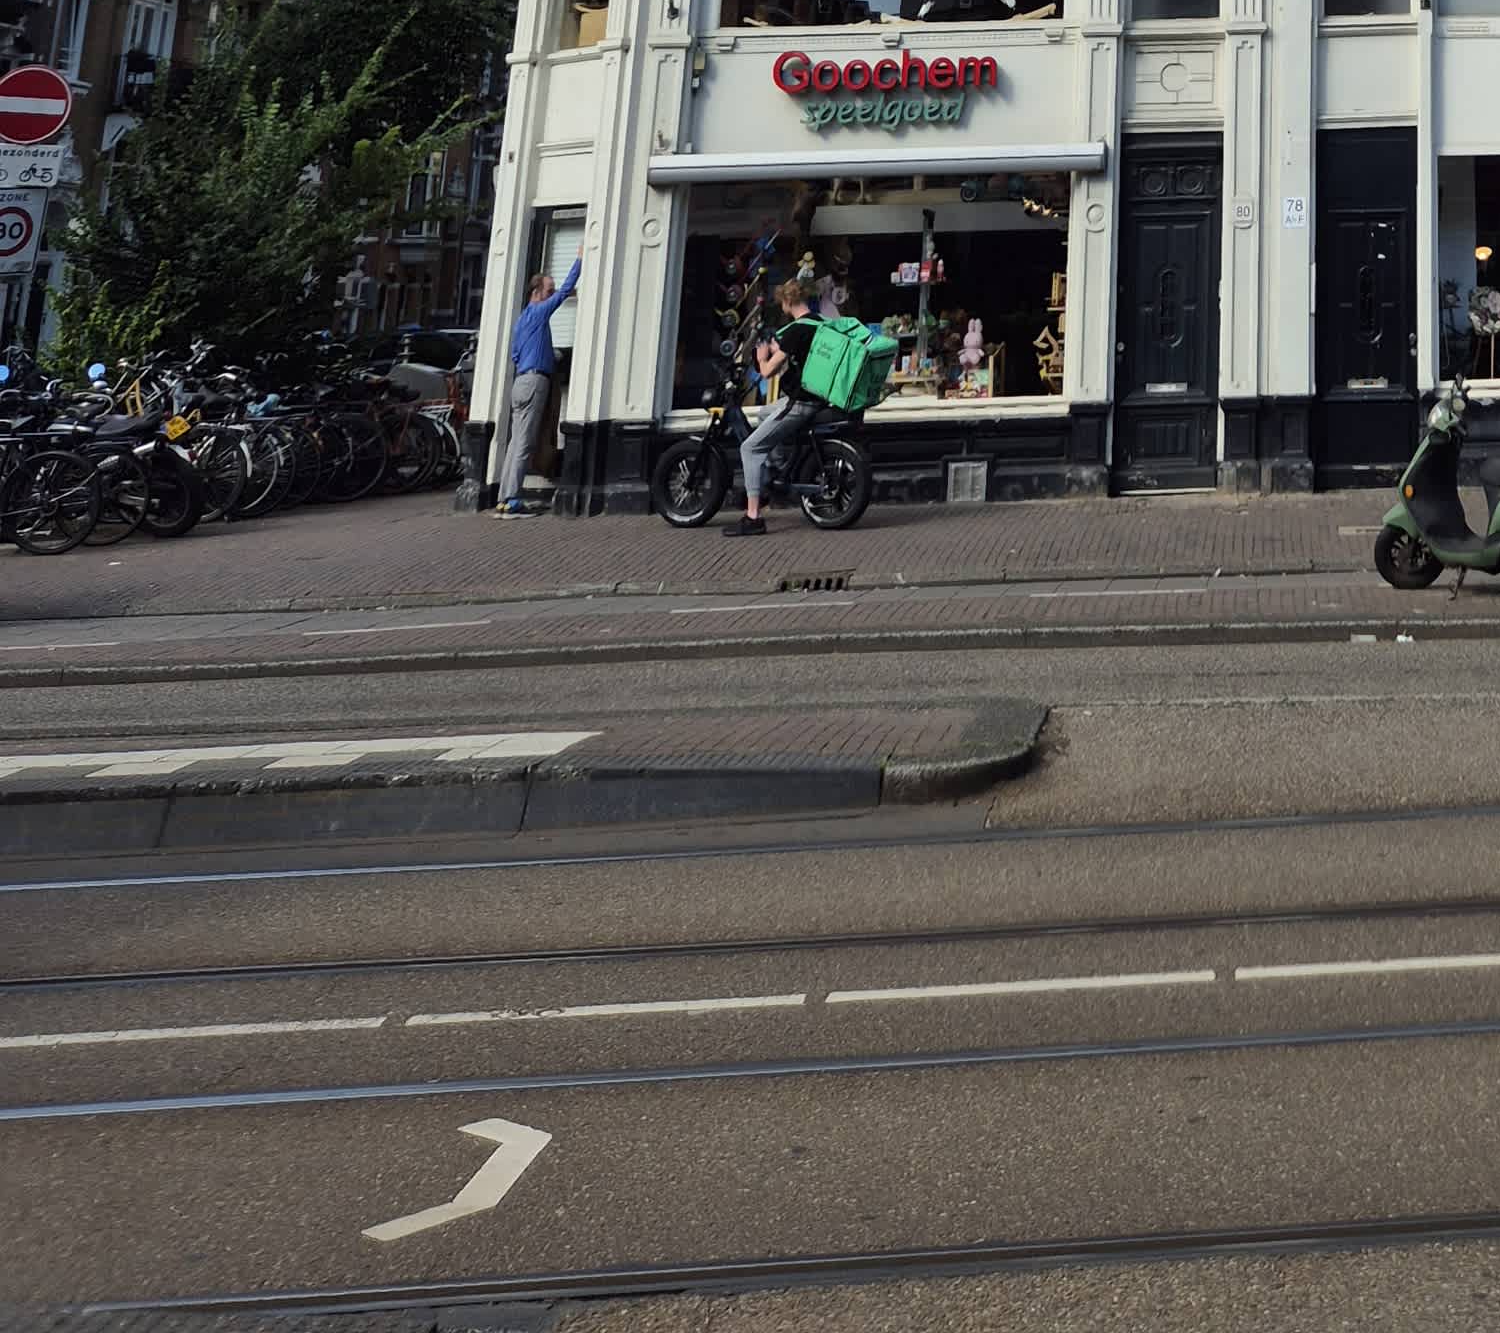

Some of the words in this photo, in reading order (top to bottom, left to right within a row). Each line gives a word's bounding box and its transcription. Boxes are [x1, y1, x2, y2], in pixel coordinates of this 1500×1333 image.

[773, 48, 999, 95] Goochem
[800, 93, 965, 131] speelgoed
[0, 148, 60, 158] ezonderd
[1236, 204, 1251, 218] 80
[1286, 198, 1304, 212] 78
